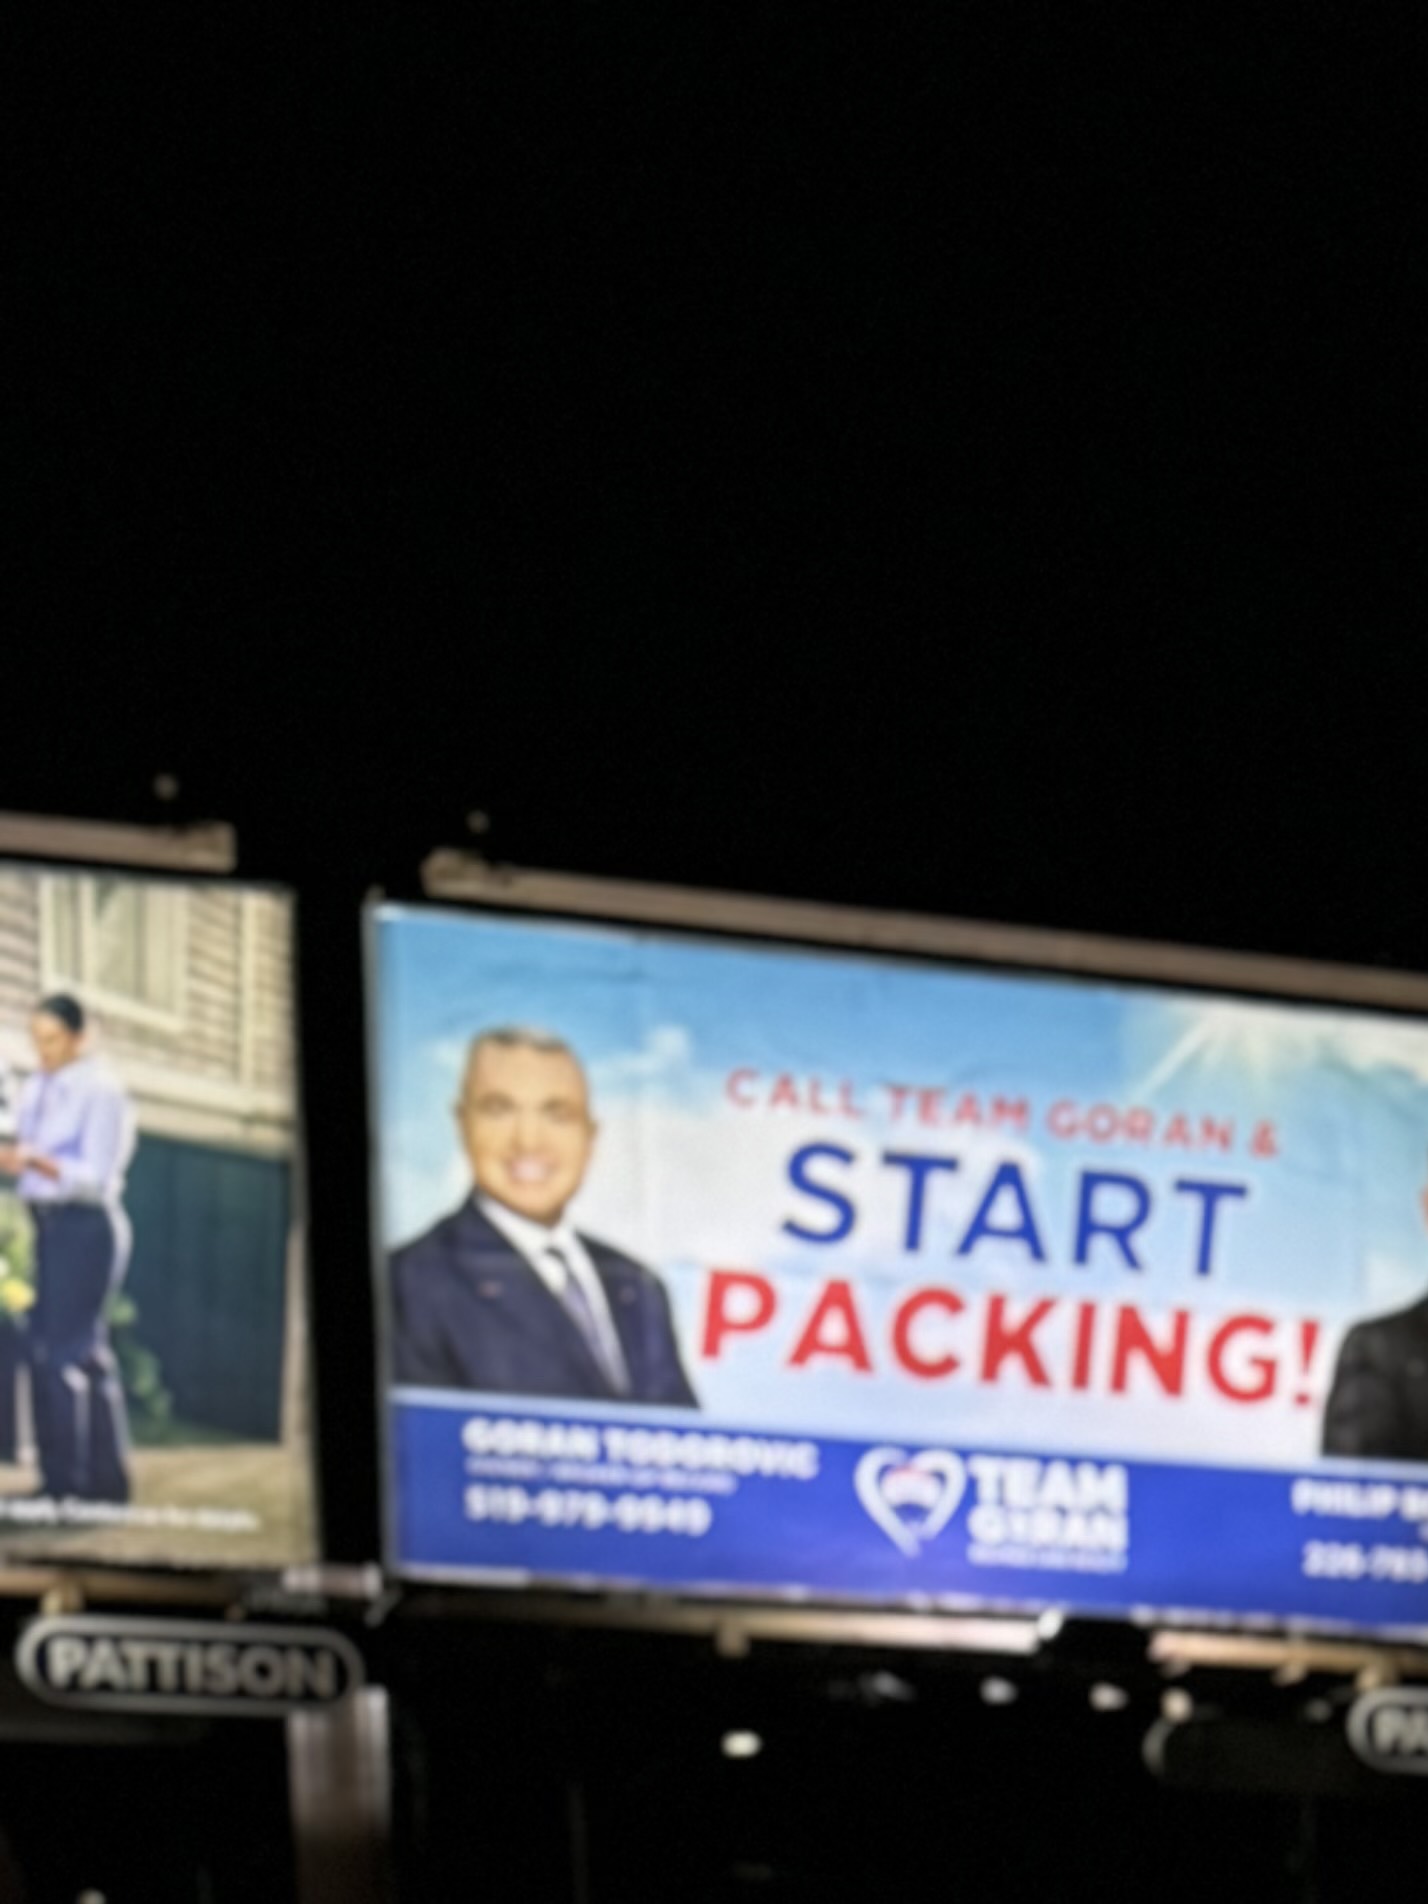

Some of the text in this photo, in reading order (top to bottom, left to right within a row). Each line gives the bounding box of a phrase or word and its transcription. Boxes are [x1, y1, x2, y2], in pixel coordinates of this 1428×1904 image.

[725, 1068, 1280, 1159] CALL TEAM GORAN &
[781, 1141, 1249, 1278] START
[700, 1270, 1321, 1408] PACKING!
[968, 1454, 1129, 1511] TEAM
[46, 1636, 338, 1698] PATTISON
